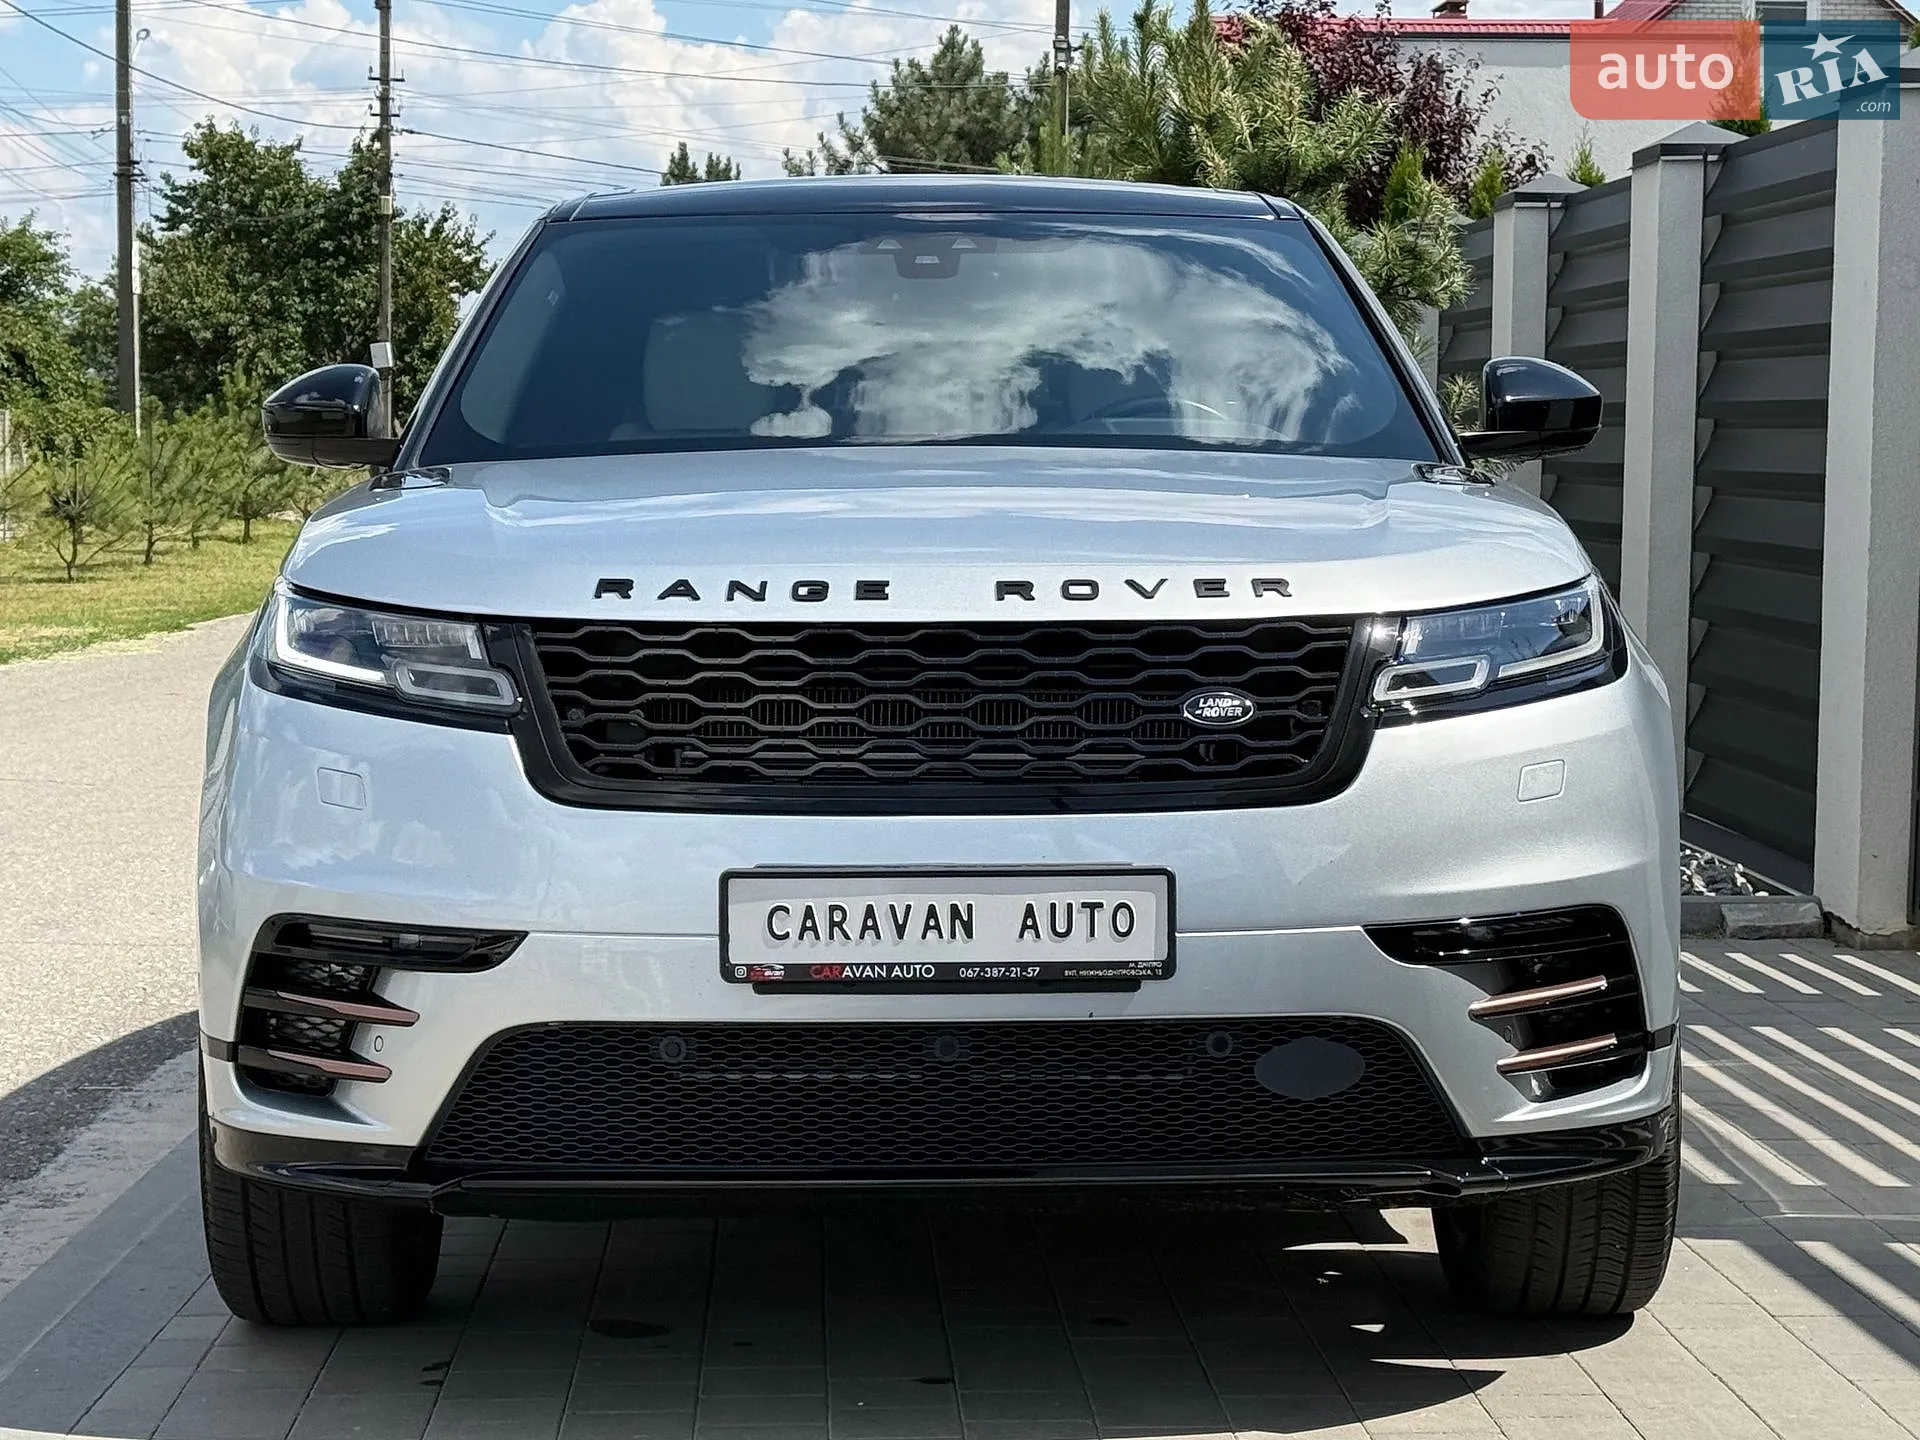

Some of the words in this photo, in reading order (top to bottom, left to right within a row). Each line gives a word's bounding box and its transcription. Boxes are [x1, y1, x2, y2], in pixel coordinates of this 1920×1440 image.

[593, 578, 890, 602] RANGE
[995, 578, 1293, 601] ROVER
[1199, 698, 1232, 707] LAND
[1202, 707, 1243, 717] ROVER
[766, 902, 974, 941] CARAVAN
[1018, 902, 1135, 939] AUTO
[809, 964, 887, 979] CARAVAN
[891, 964, 935, 978] AUTO
[959, 966, 1040, 978] 067-387-21-57
